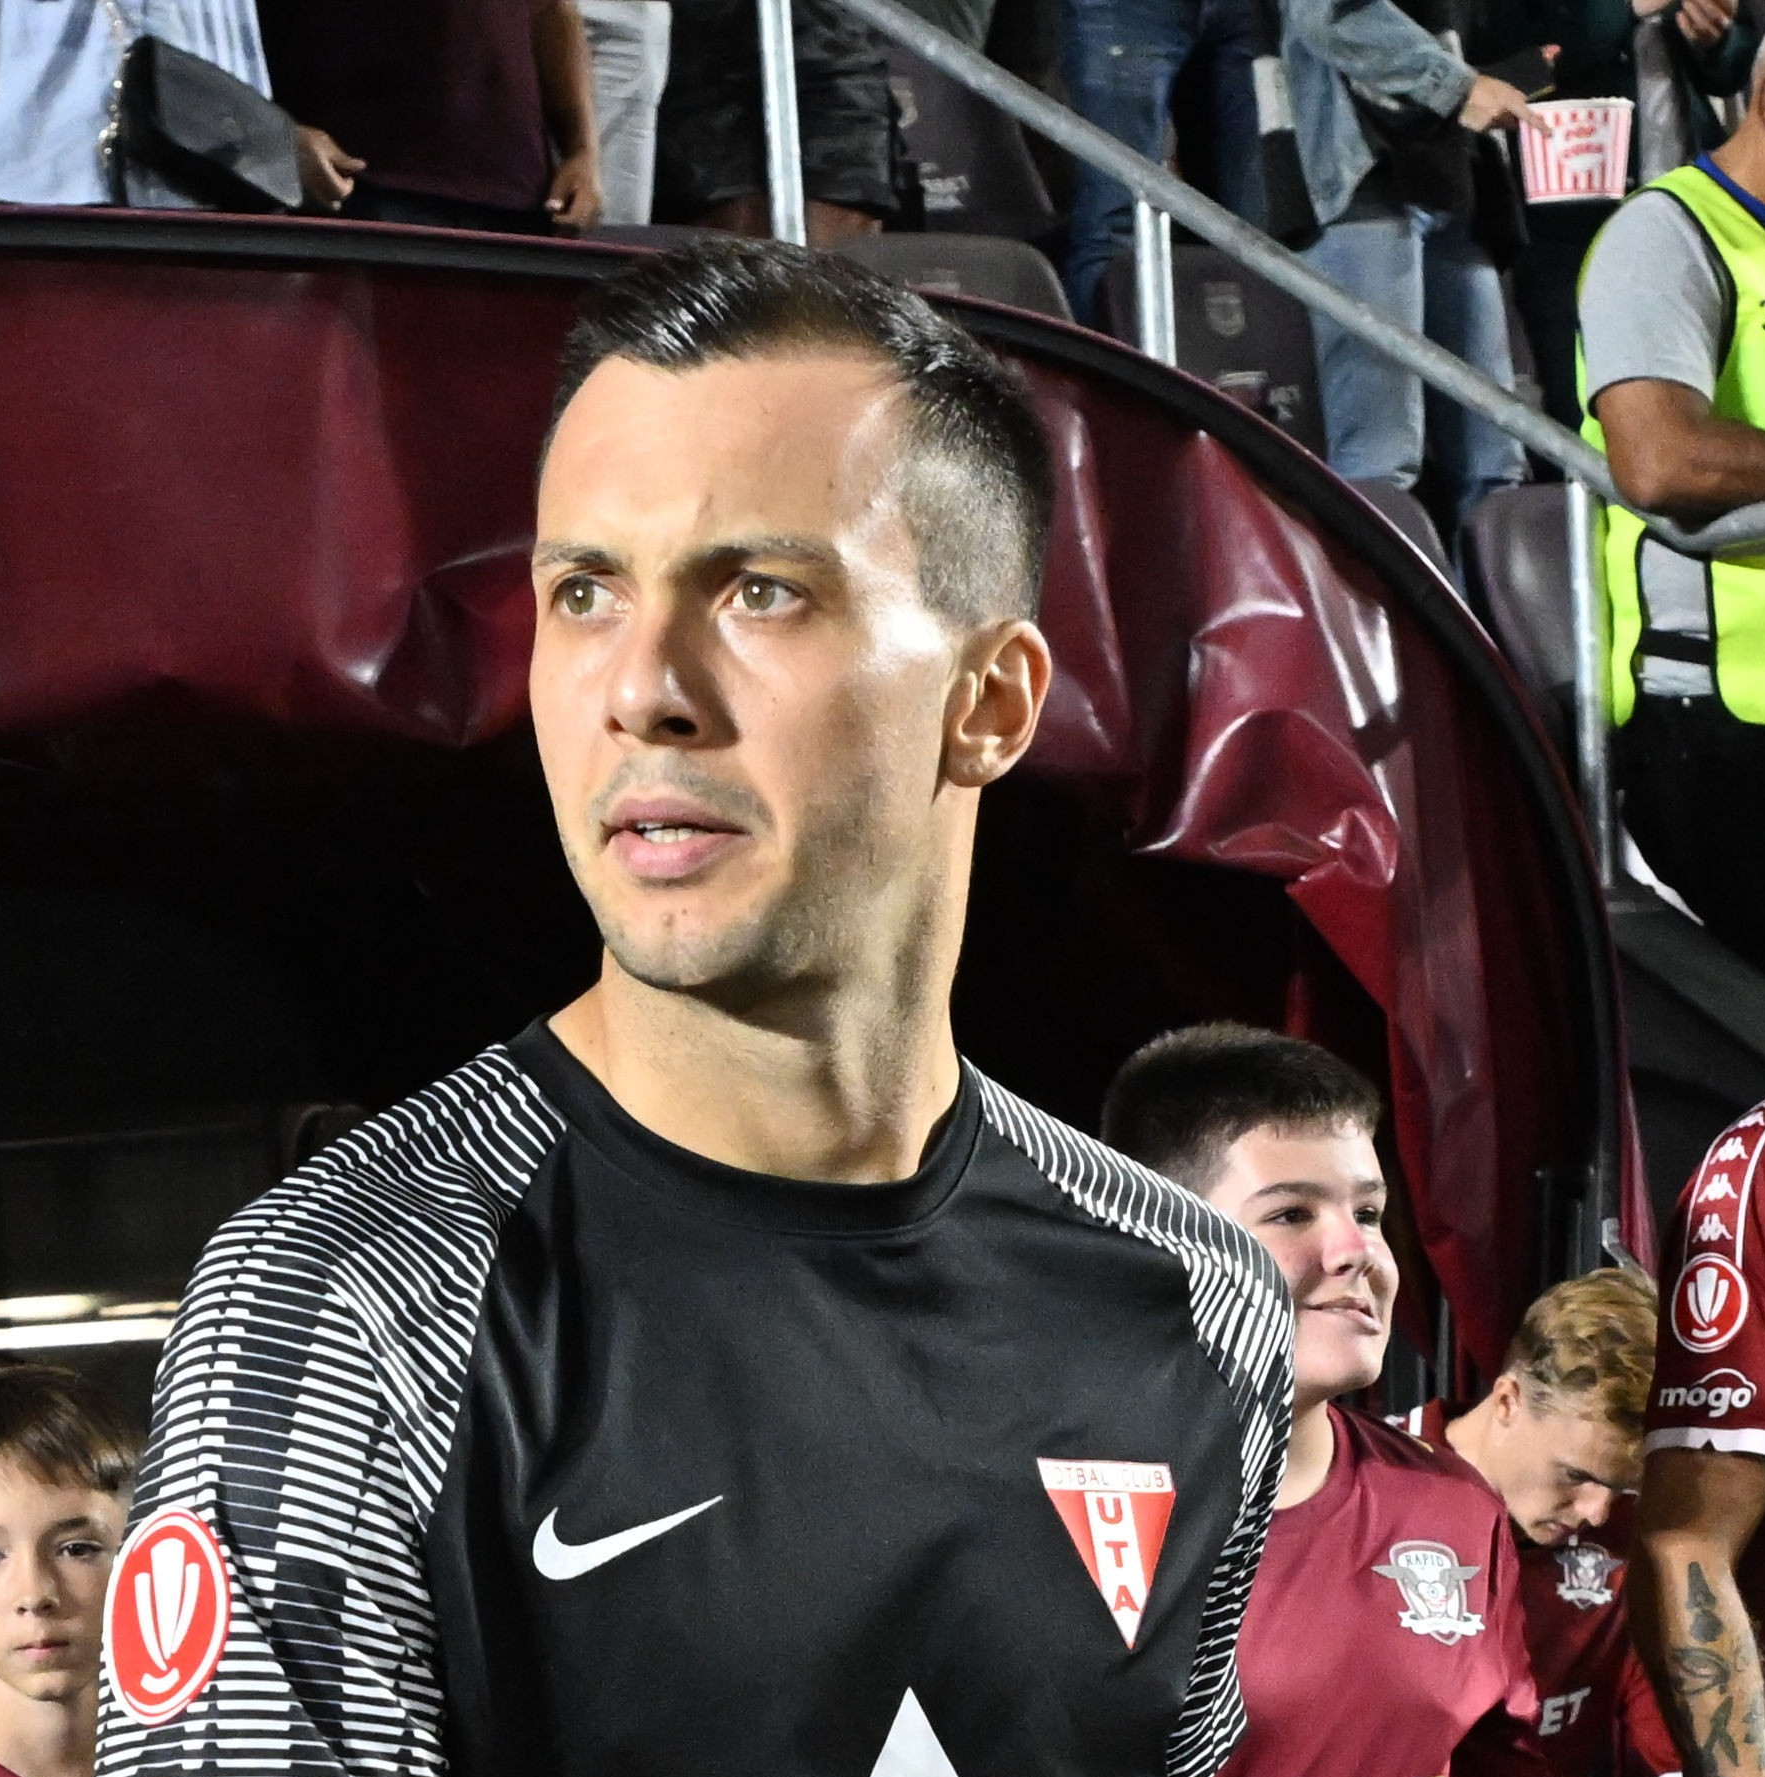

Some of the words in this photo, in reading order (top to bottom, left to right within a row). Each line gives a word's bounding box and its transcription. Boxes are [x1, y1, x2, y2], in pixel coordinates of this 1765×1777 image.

[1658, 1383, 1753, 1418] mogo
[1045, 1465, 1110, 1487] OTBAL
[1404, 1553, 1445, 1567] RAPID
